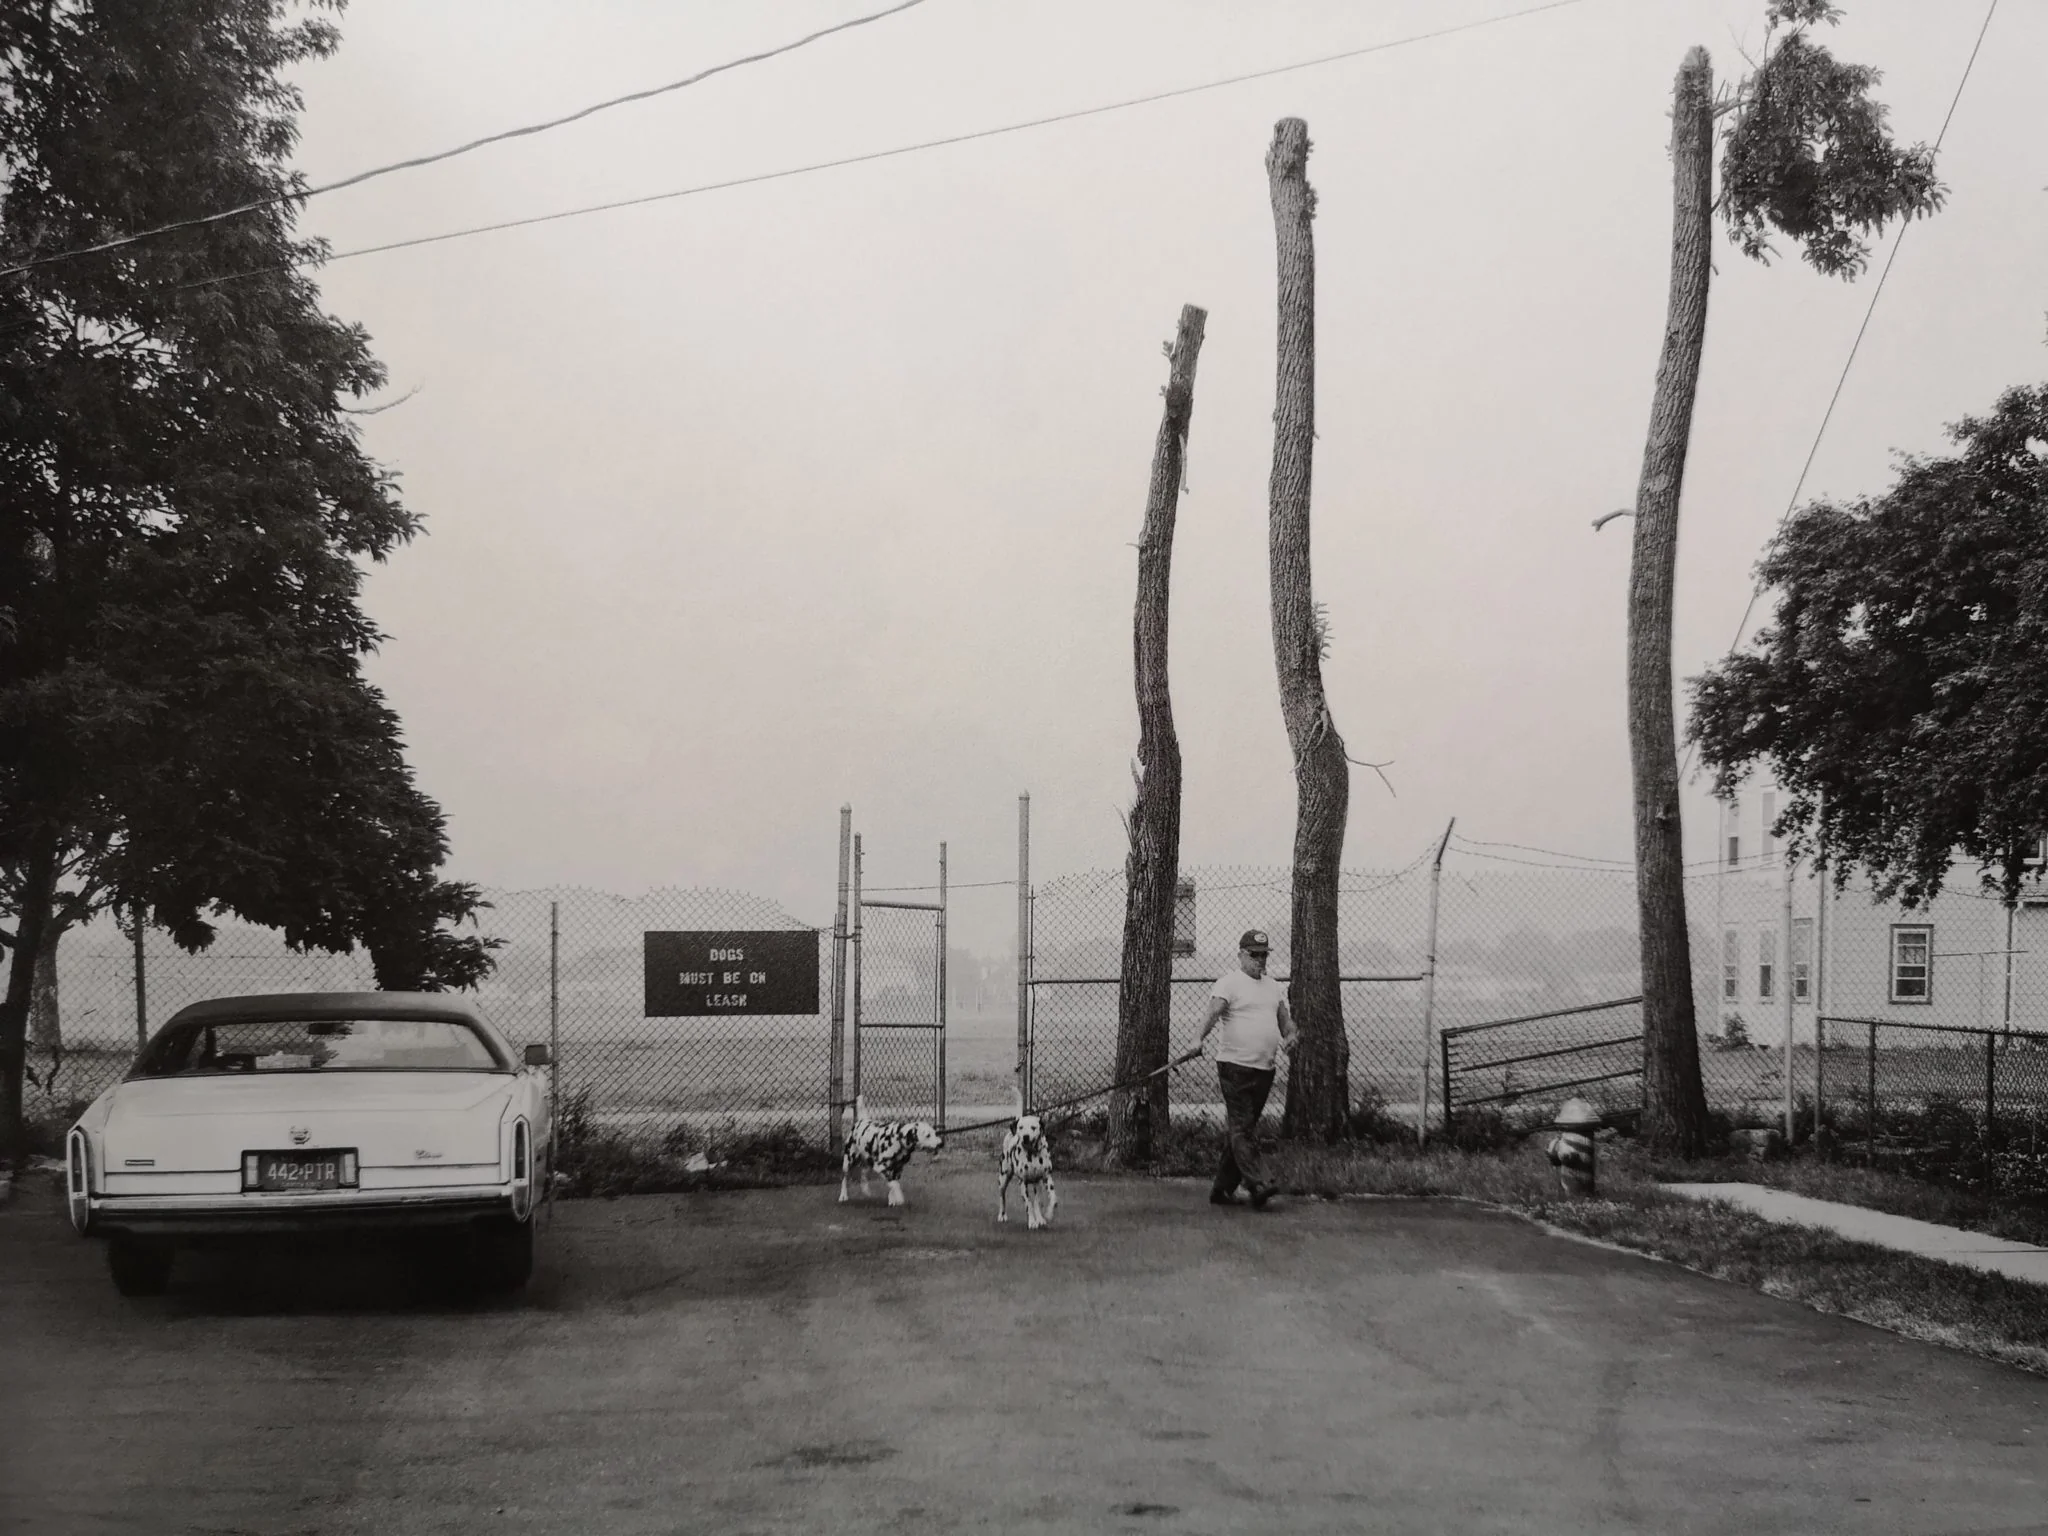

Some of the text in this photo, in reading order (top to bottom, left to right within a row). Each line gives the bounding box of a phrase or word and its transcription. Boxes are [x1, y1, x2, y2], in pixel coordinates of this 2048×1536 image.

[709, 948, 744, 961] DOGS
[679, 972, 766, 985] MUST BE ON
[706, 994, 747, 1007] LEASH
